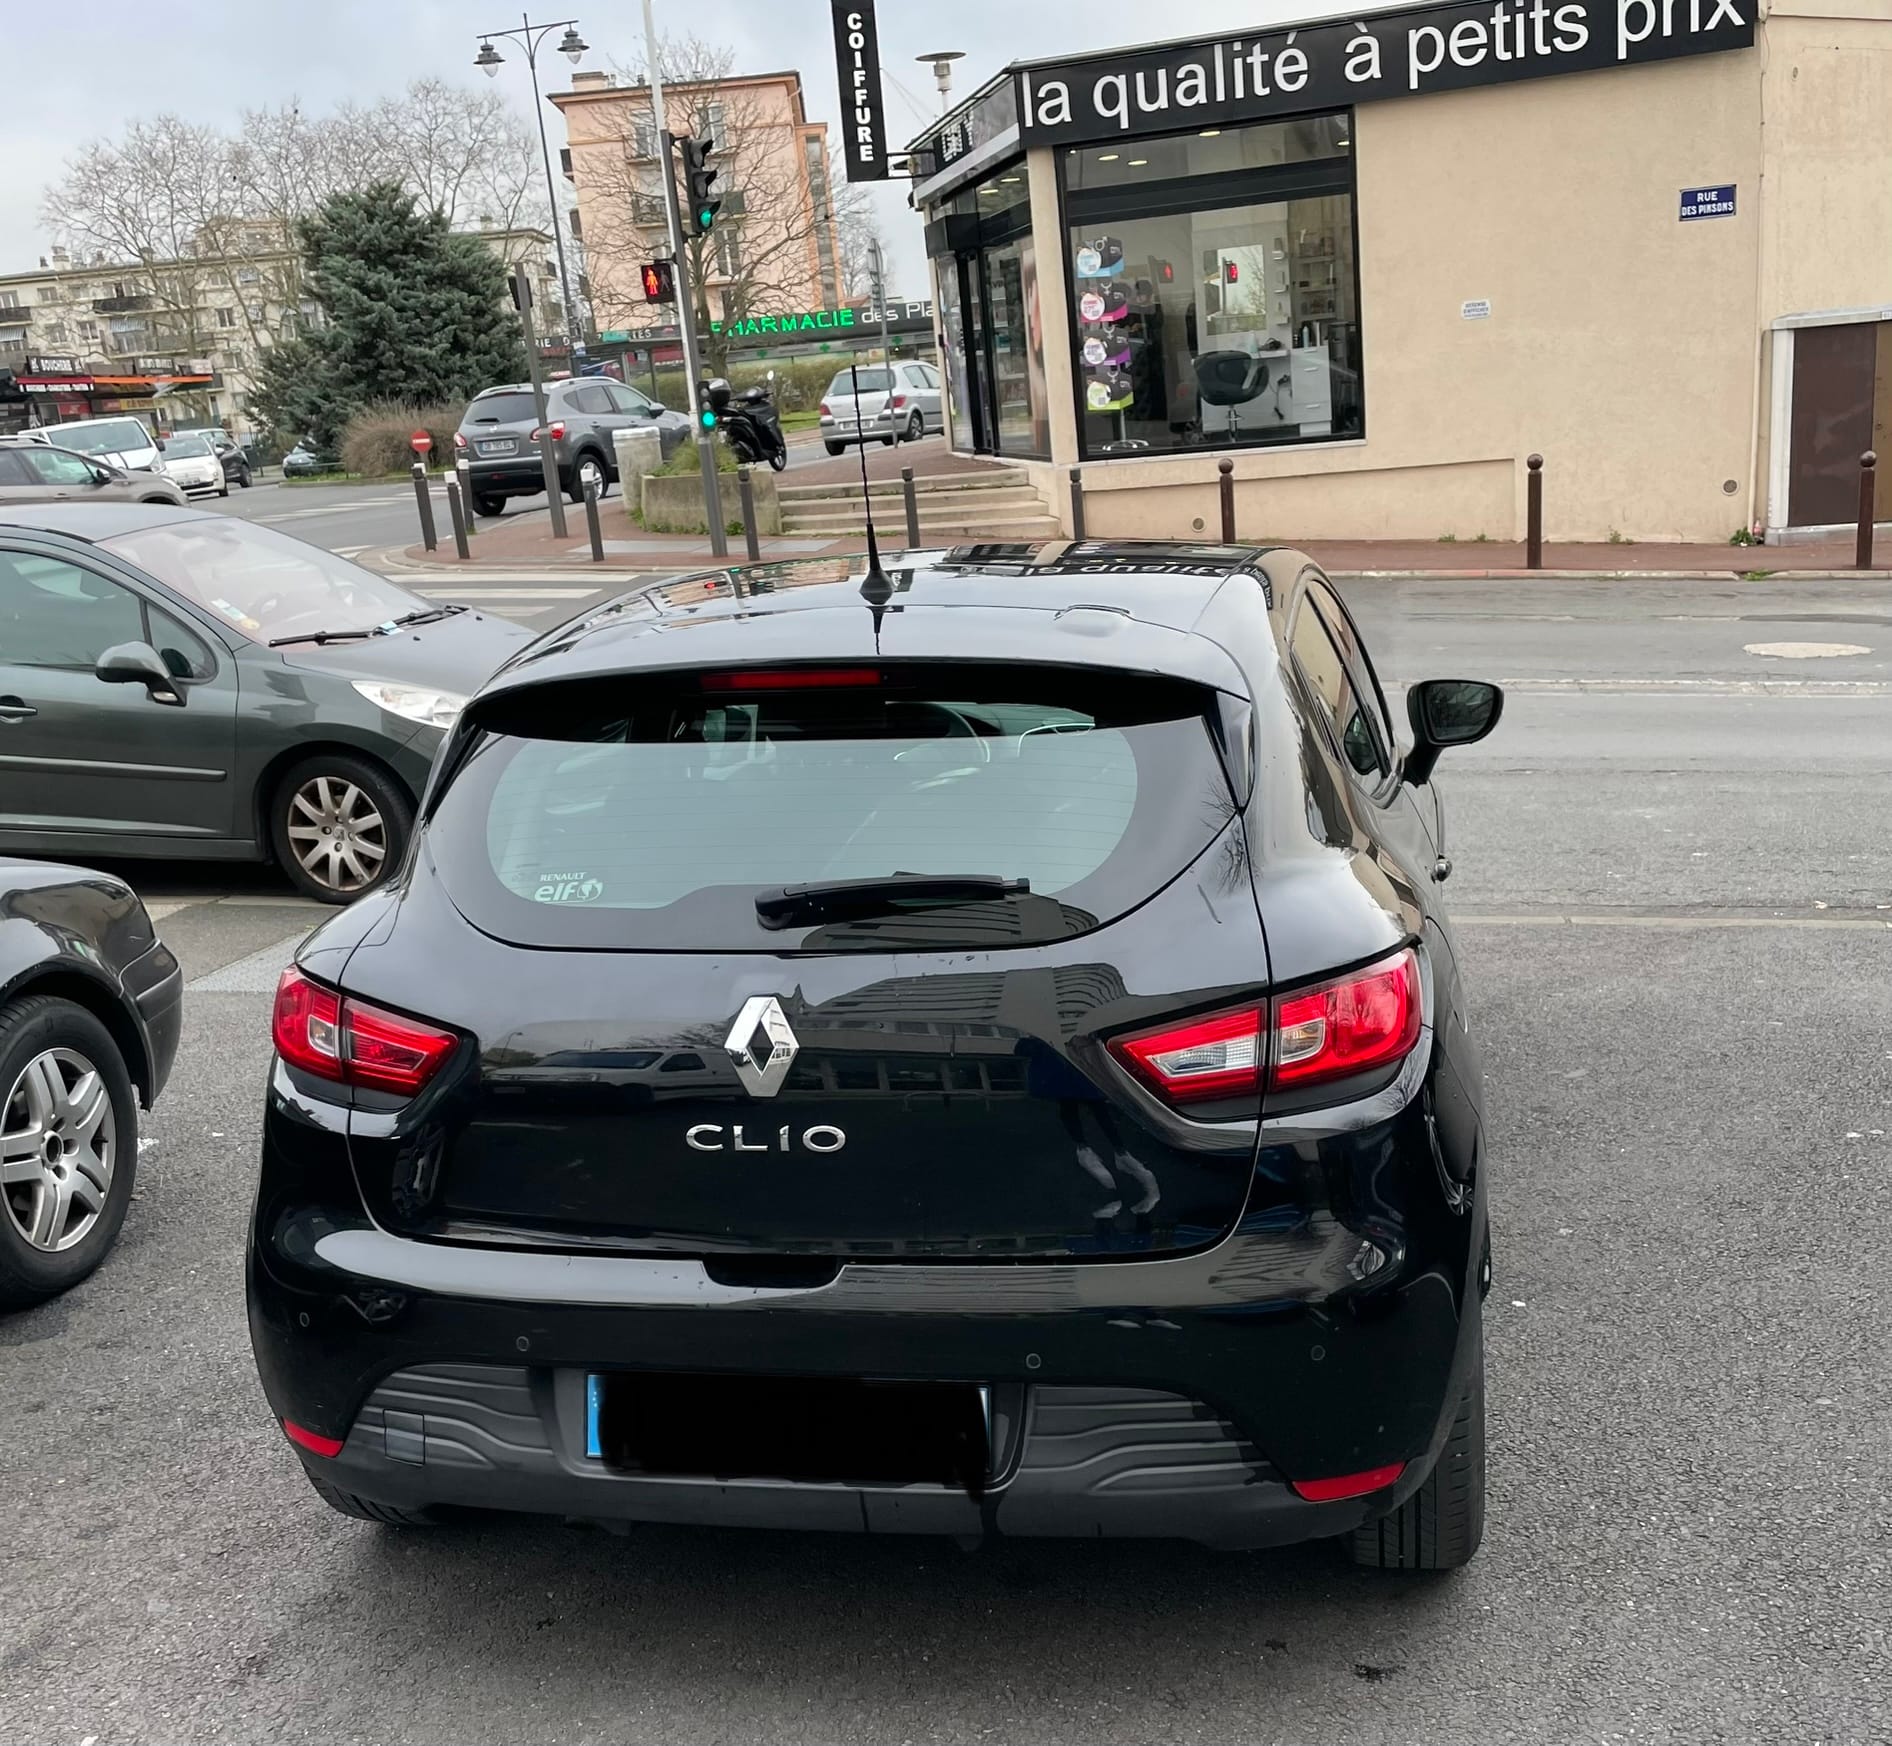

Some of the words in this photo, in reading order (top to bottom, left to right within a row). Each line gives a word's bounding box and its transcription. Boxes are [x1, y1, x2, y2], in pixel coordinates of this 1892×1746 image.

[1022, 71, 1072, 128] la
[1093, 31, 1308, 129] qualité
[1344, 21, 1383, 82] à
[1408, 0, 1590, 90] petits
[1617, 0, 1746, 60] prix
[847, 12, 874, 162] COIFFURE
[1697, 191, 1718, 202] RUE
[1682, 205, 1697, 216] DES
[1698, 201, 1734, 214] PINSONS
[862, 309, 899, 323] des
[539, 871, 588, 882] RENAULT
[534, 881, 579, 902] elf
[686, 1124, 846, 1152] CLIO
